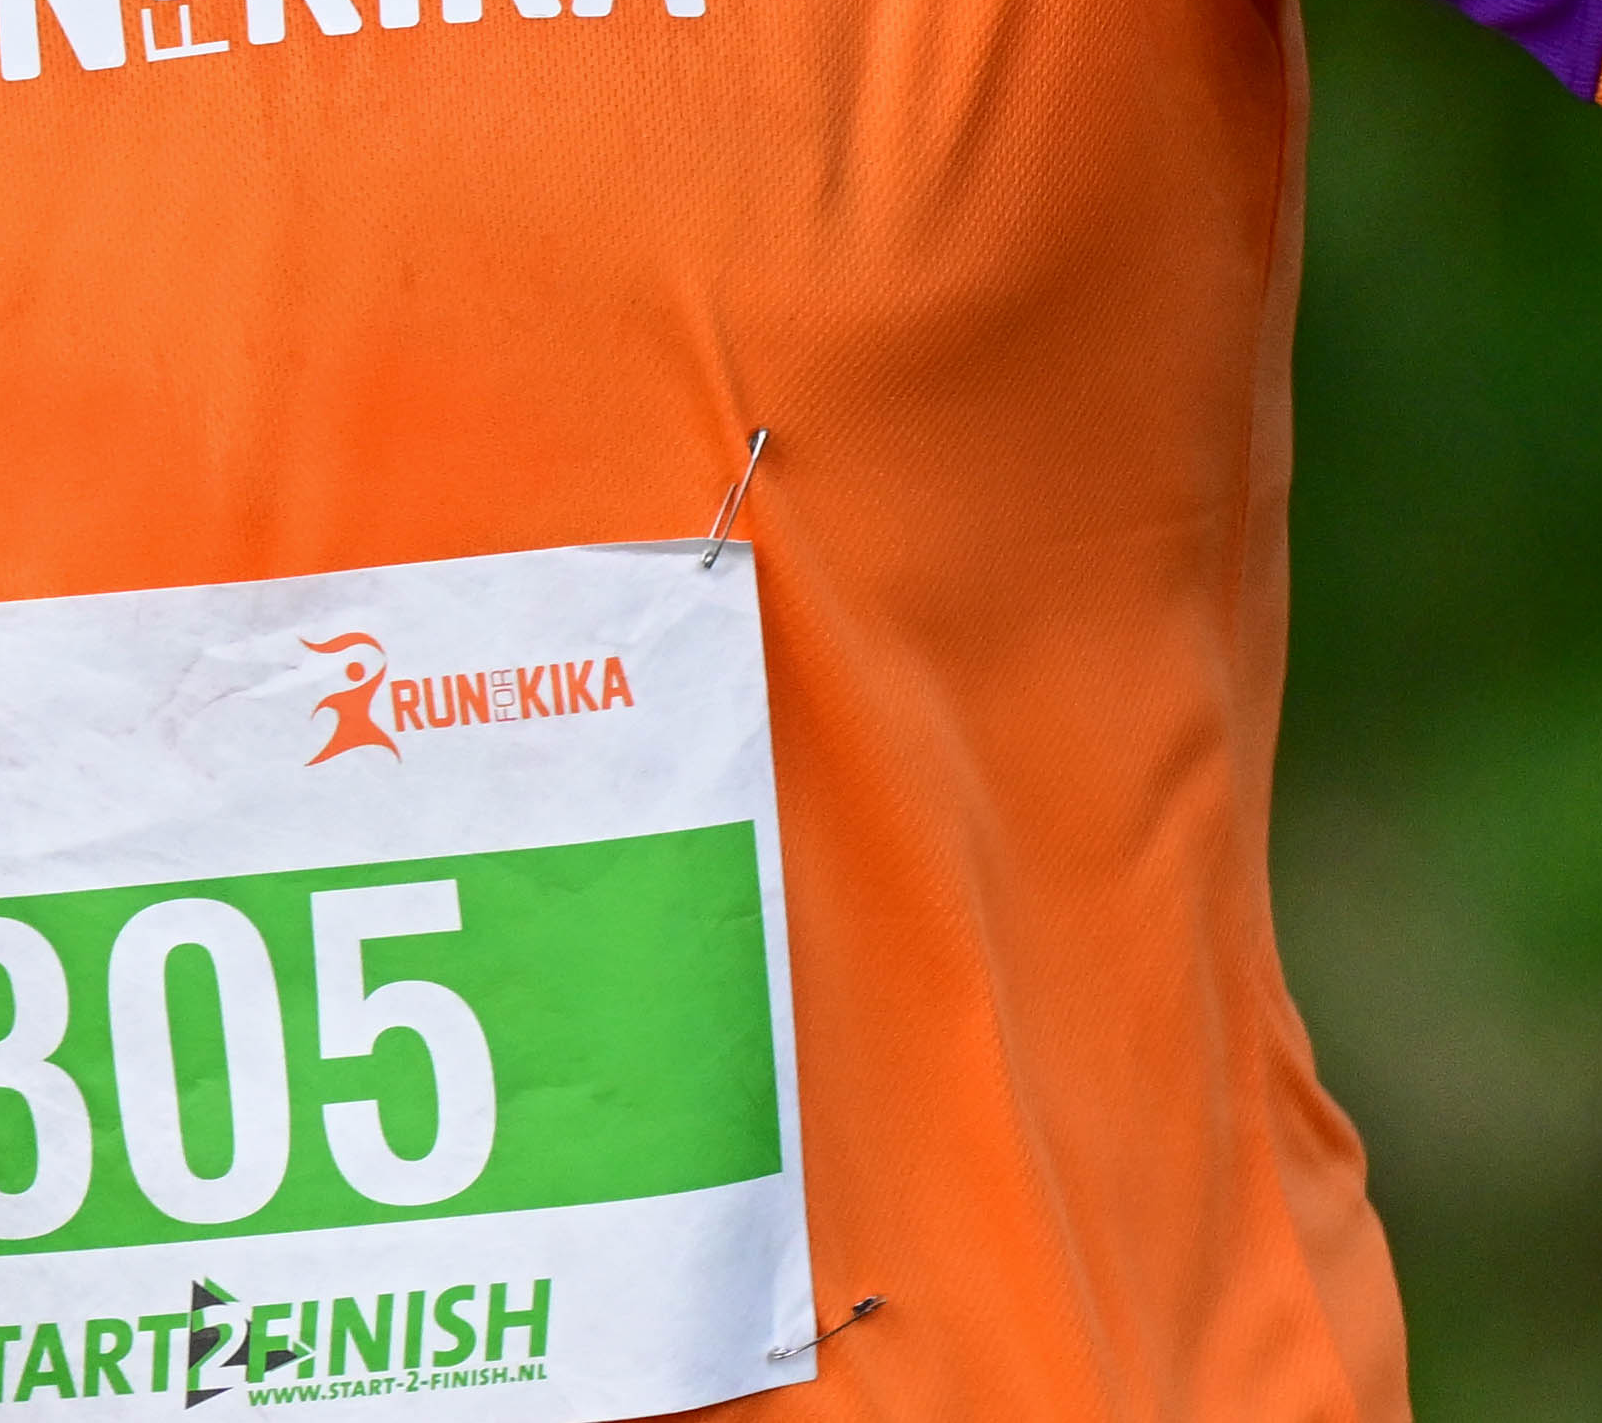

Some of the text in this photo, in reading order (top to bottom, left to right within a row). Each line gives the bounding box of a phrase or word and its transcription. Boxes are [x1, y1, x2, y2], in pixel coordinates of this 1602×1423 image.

[390, 655, 635, 733] RUN FOR KIKA
[247, 1365, 549, 1408] WWW.START-2-FINISH.NL
